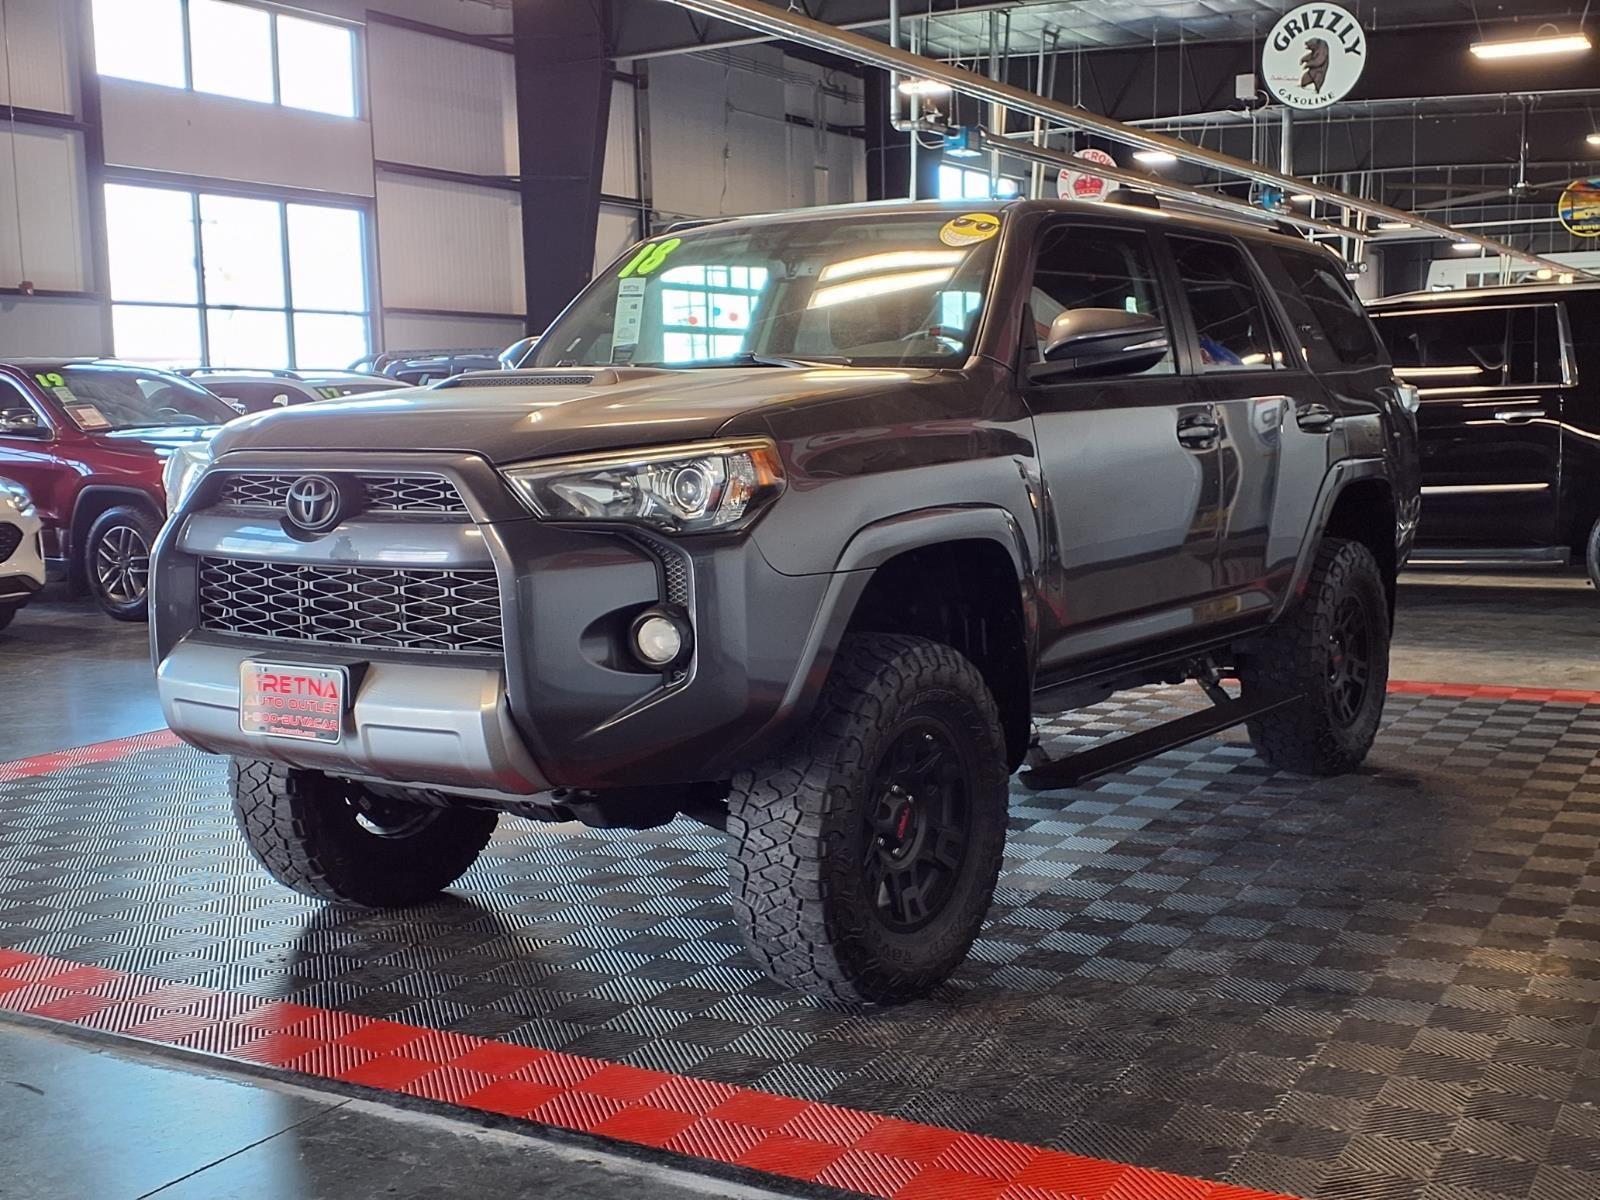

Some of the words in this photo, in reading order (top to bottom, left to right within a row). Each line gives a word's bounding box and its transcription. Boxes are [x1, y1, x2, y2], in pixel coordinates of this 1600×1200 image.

[1273, 9, 1361, 56] GRIZZLY
[1278, 88, 1335, 105] GASOLINE
[617, 238, 681, 277] 18
[35, 373, 64, 387] 19
[288, 699, 339, 714] OUTLET
